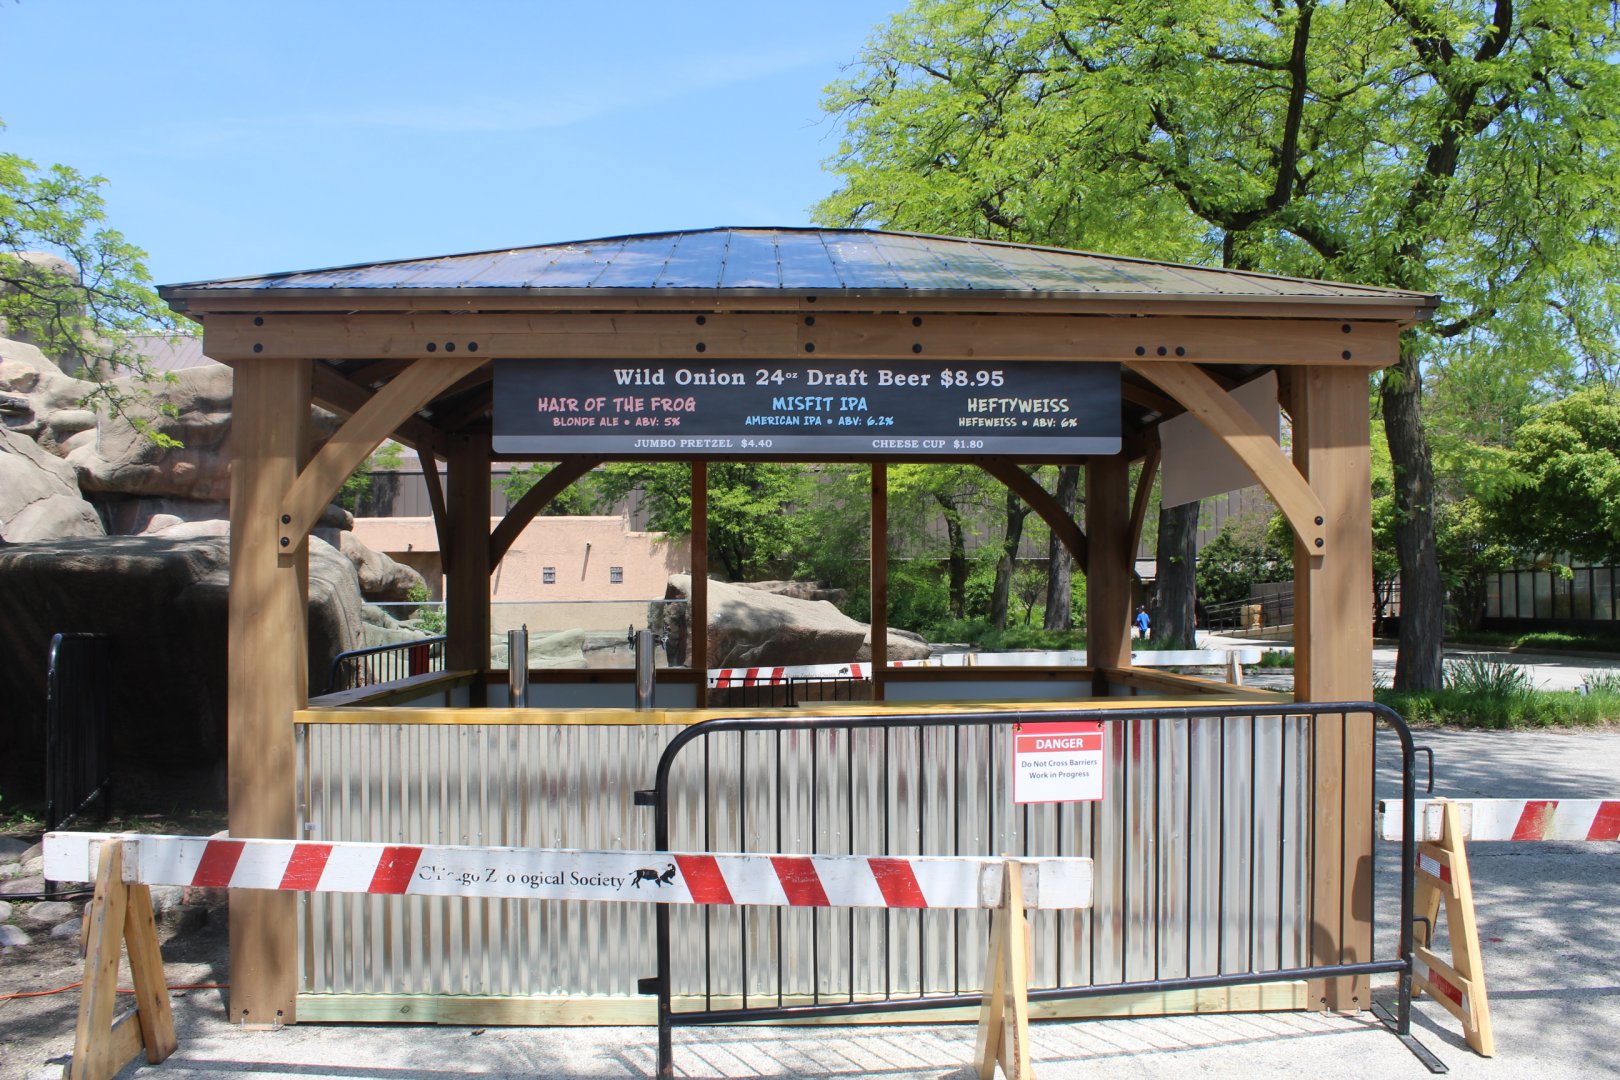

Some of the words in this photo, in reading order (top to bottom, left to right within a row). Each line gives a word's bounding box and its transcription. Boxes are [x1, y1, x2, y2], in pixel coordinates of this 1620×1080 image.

[613, 368, 666, 386] Wild
[674, 368, 746, 386] Onion
[806, 368, 869, 386] Draft
[877, 369, 931, 387] Beer
[940, 368, 1005, 389] $8.95
[538, 397, 579, 413] HAIR
[584, 397, 607, 412] OF
[612, 396, 645, 412] THE
[650, 396, 697, 413] FROG
[772, 396, 834, 412] MISFIT
[839, 396, 868, 412] IPA
[967, 397, 1071, 414] HEFTYWEISS
[552, 417, 596, 427] BLONDE
[599, 417, 620, 427] ALE
[635, 417, 659, 427] ABV:
[663, 417, 681, 427] 5%
[744, 415, 800, 426] AMERICAN
[803, 415, 822, 426] IPA
[837, 415, 862, 426] ABV:
[866, 415, 895, 426] 6.2%
[958, 416, 1018, 428] HEFEWEISS
[1032, 417, 1056, 428] ABV:
[1060, 417, 1079, 428] 6%
[634, 439, 676, 449] JUMBO
[680, 439, 734, 449] PRETZEL
[740, 438, 773, 449] $4.40
[872, 439, 919, 449] CHEESE
[922, 439, 946, 449] CUP
[953, 438, 984, 450] $1.80
[1036, 738, 1084, 750] DANGER
[1021, 760, 1032, 768] Do
[1033, 760, 1047, 768] Not
[1048, 759, 1068, 767] Cross
[1069, 758, 1098, 766] Barriers
[1029, 771, 1048, 779] Work
[1058, 770, 1090, 780] Progress
[485, 867, 565, 890] Zoogical
[569, 870, 626, 892] Society
